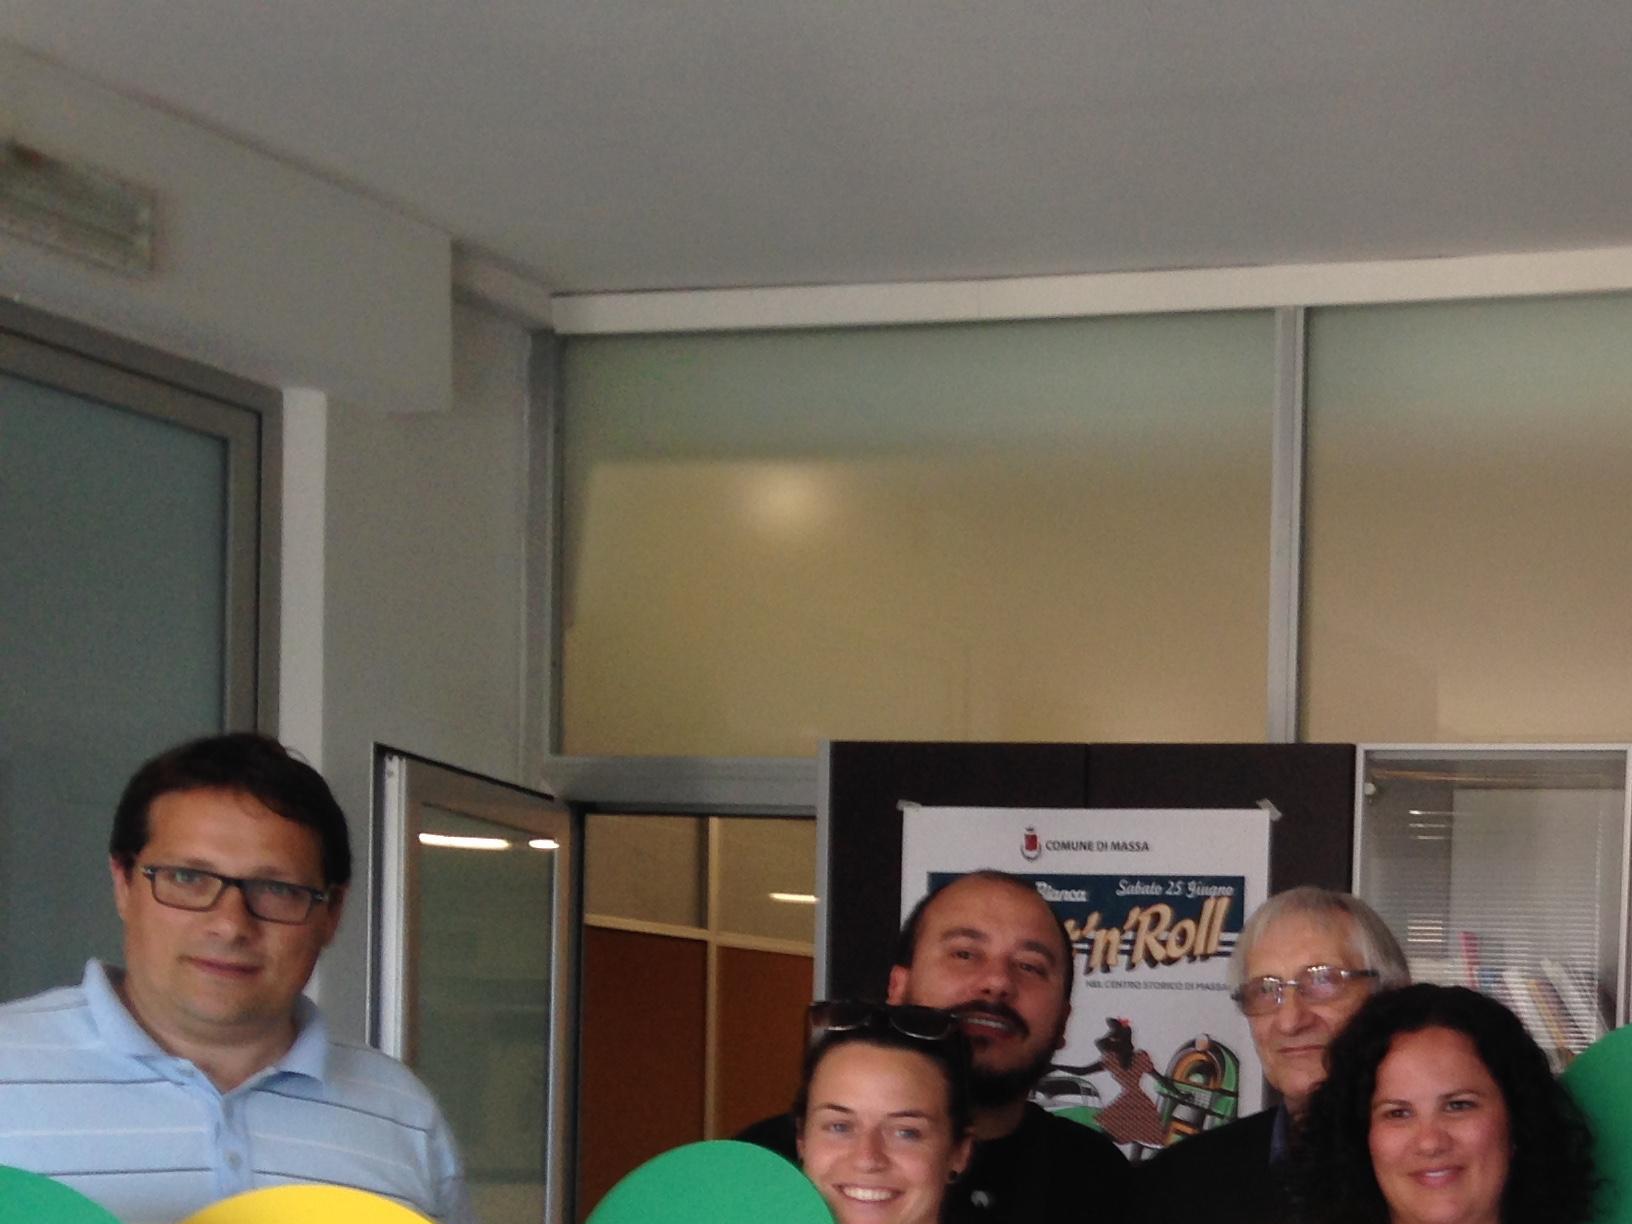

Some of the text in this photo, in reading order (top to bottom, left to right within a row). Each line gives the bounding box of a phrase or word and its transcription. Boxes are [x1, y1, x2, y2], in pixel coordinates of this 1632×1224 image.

[1046, 841, 1150, 852] COMUNE DI MASSA
[1116, 879, 1235, 898] Sabato 25 Giugno
